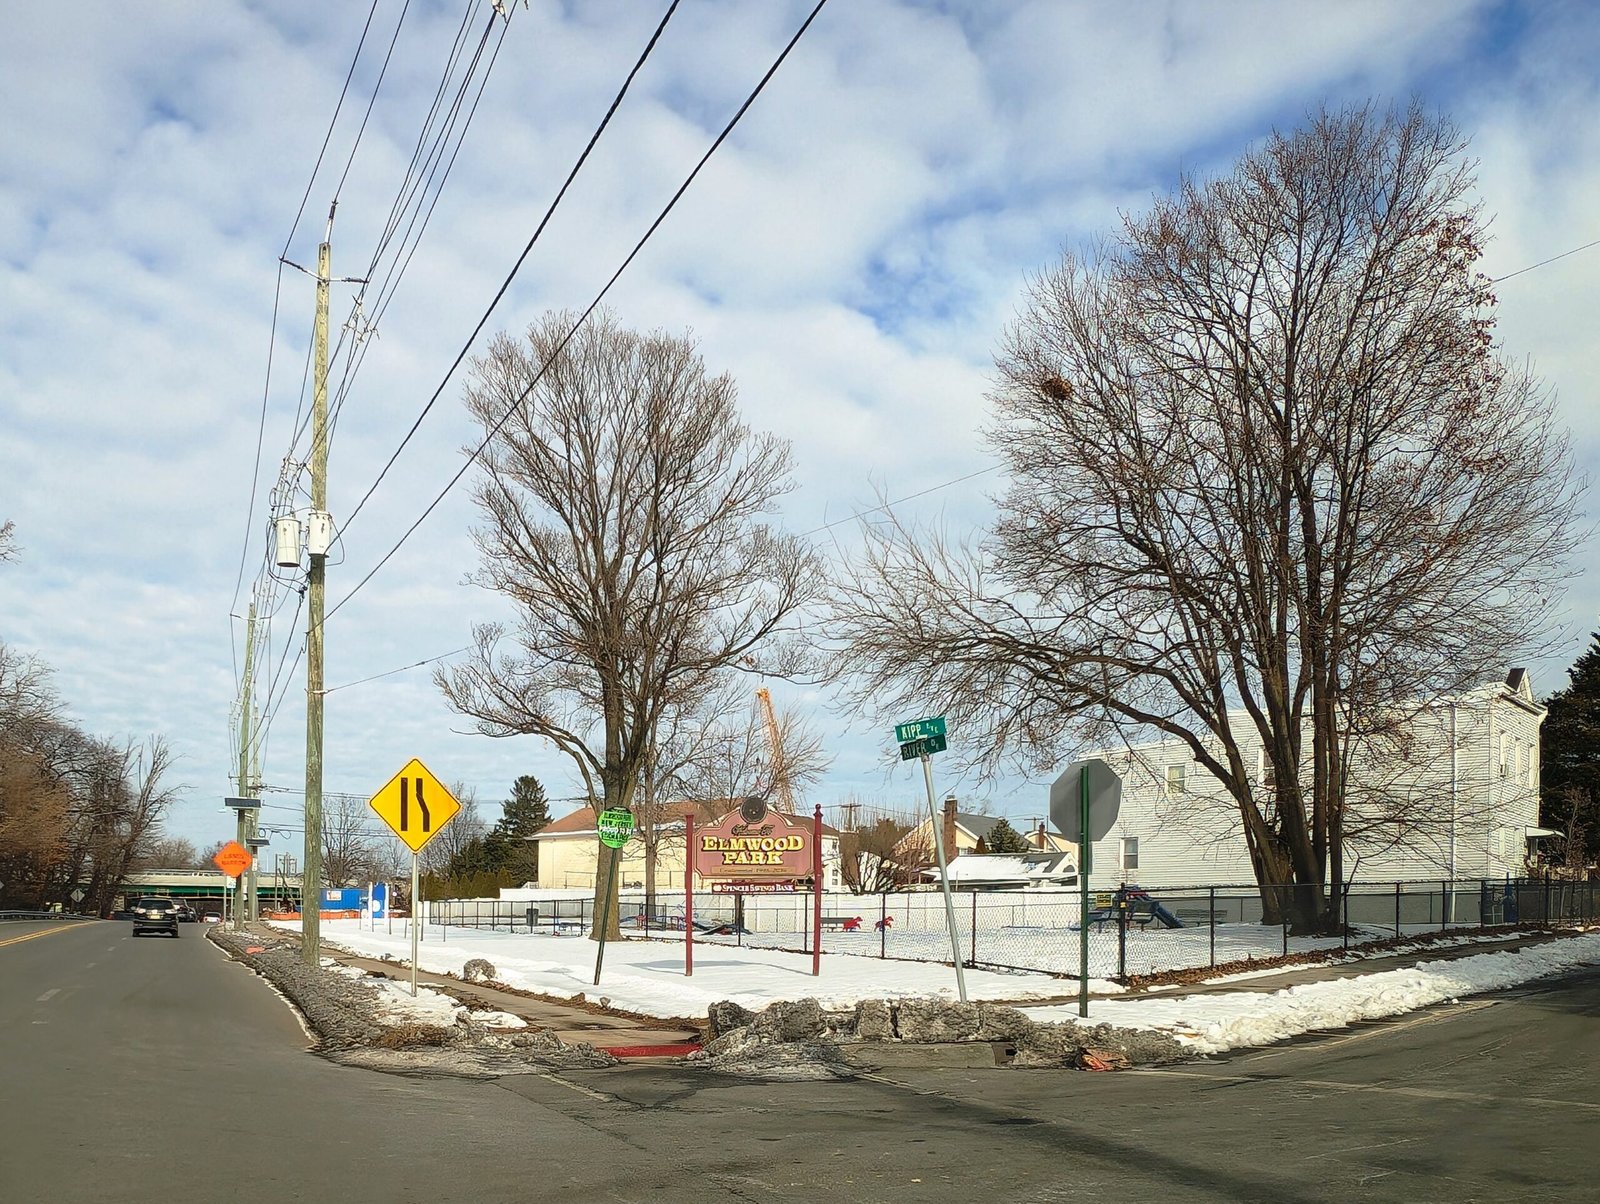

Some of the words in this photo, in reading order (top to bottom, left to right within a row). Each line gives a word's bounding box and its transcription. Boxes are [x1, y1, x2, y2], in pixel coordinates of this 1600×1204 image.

[901, 724, 921, 739] KIPP
[902, 742, 927, 758] RIVER
[702, 835, 805, 851] ELMWOOD
[722, 851, 784, 865] PARK
[775, 884, 794, 892] BANK
